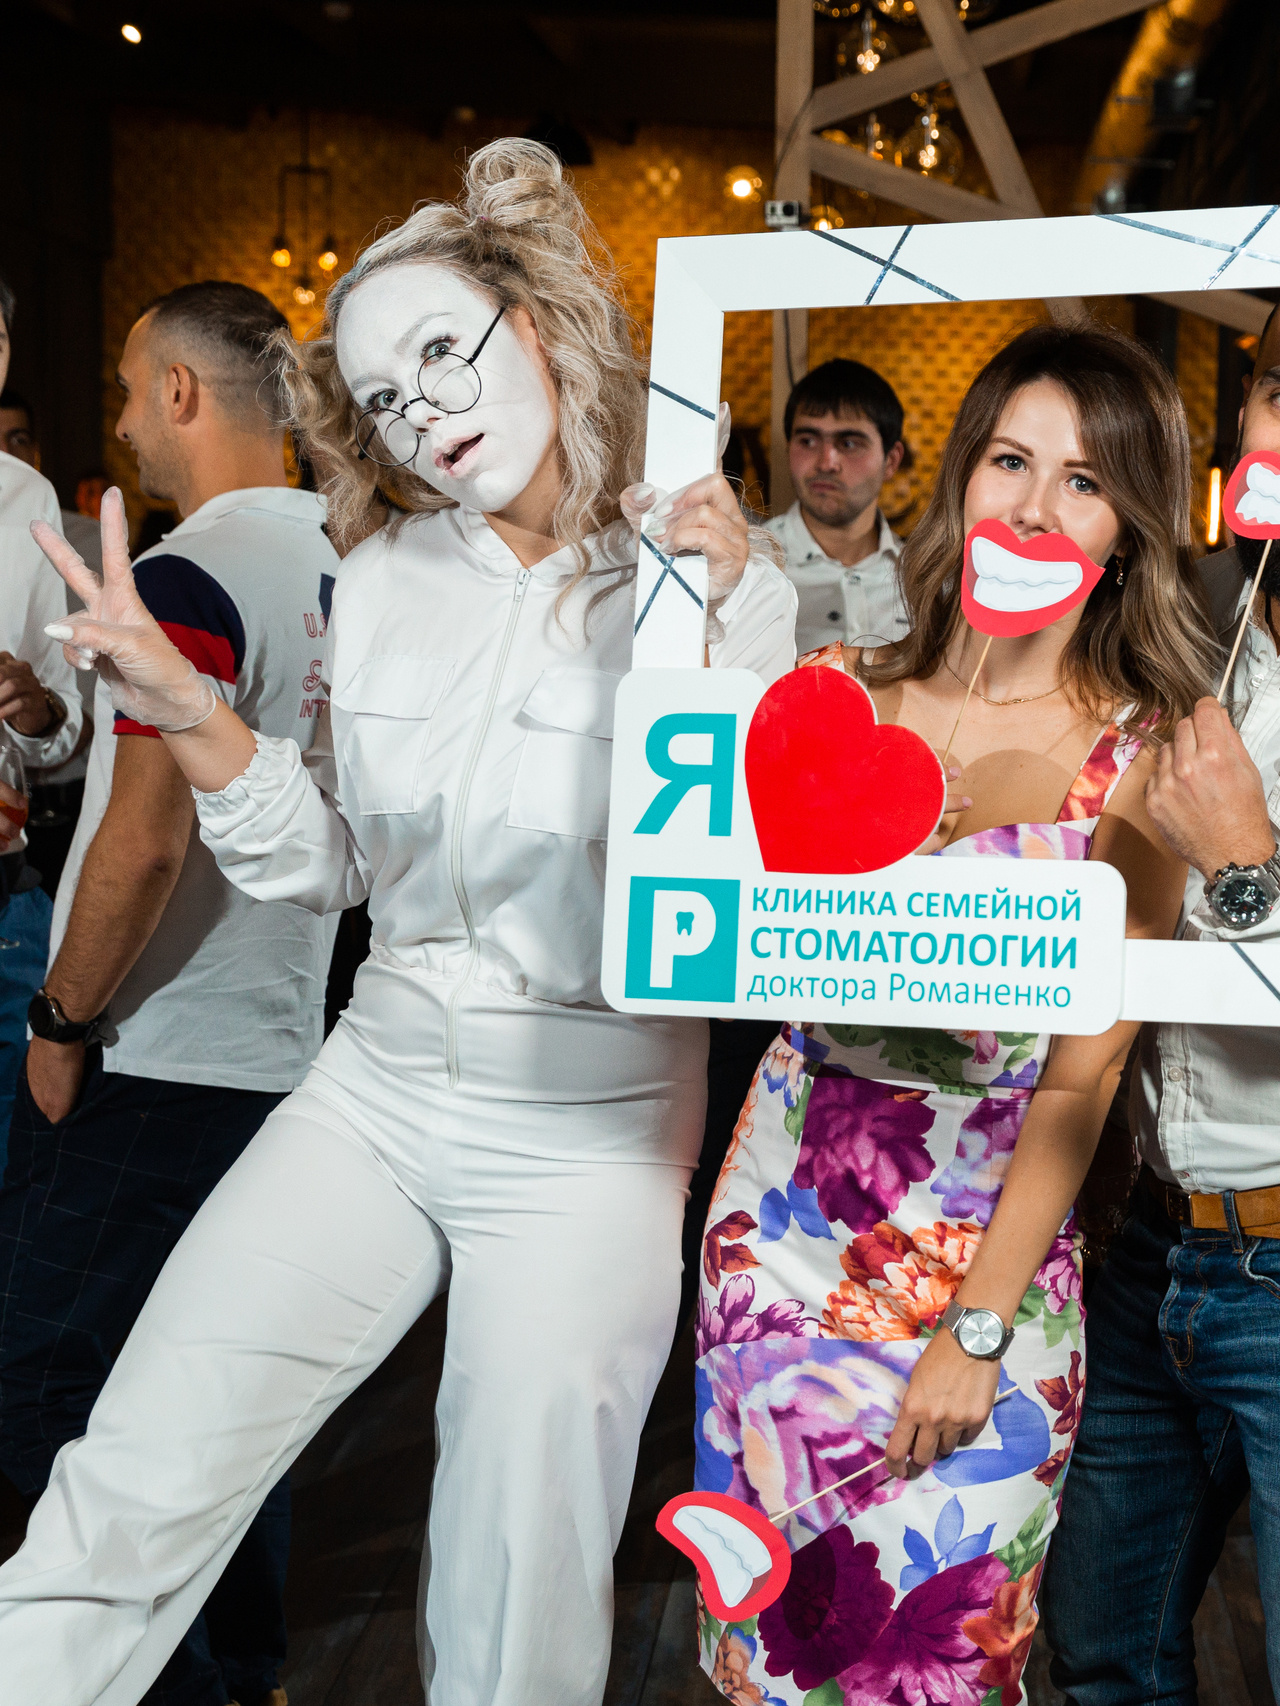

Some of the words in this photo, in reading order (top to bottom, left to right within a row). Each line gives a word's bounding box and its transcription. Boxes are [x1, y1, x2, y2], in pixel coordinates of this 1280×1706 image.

[632, 712, 738, 838] Я
[751, 886, 898, 917] КЛИНИКА
[906, 886, 1082, 922] СЕМЕЙНОЙ
[749, 925, 1079, 971] СТОМАТОЛОГИИ
[746, 973, 877, 1007] доктора
[888, 971, 1073, 1009] Романенко
